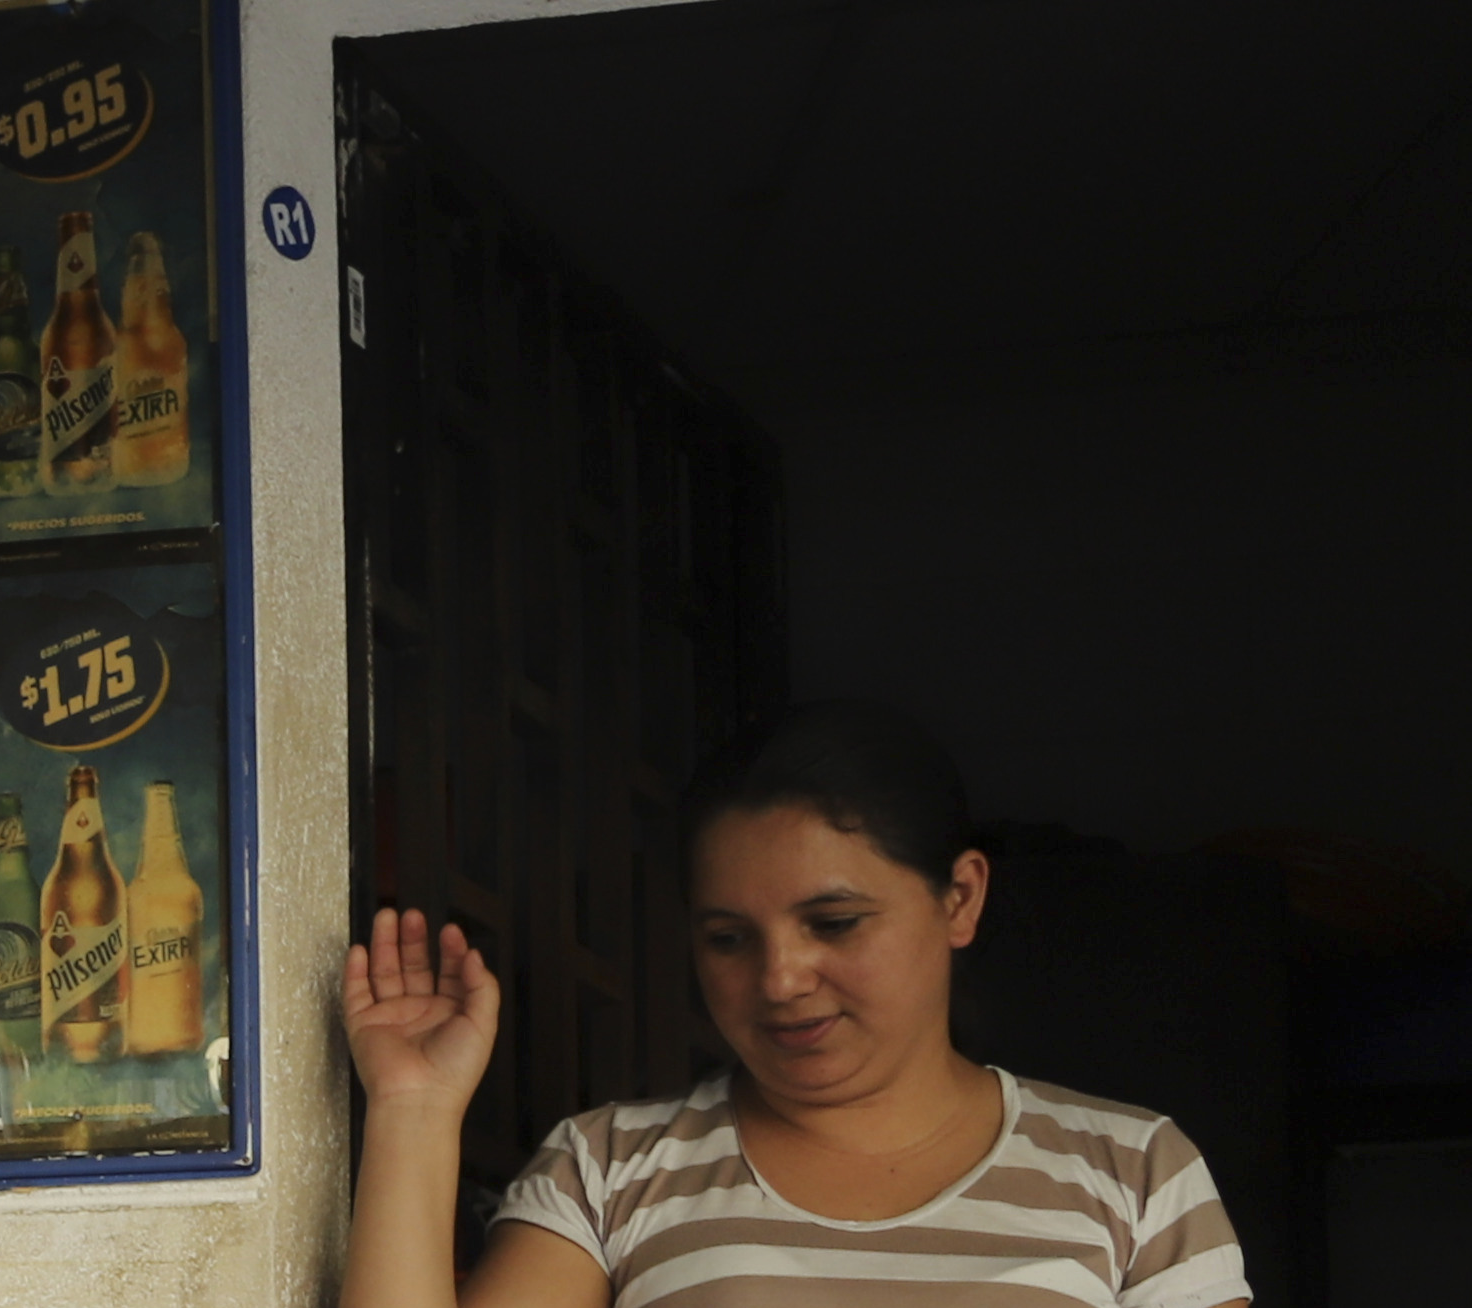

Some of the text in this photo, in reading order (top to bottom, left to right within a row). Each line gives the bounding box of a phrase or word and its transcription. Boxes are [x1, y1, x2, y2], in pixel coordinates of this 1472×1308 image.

[270, 202, 309, 247] R1
[46, 365, 114, 441] Pilsener
[116, 389, 179, 427] EXTRA
[20, 635, 136, 726] $1.75
[48, 924, 123, 1001] Pilsener
